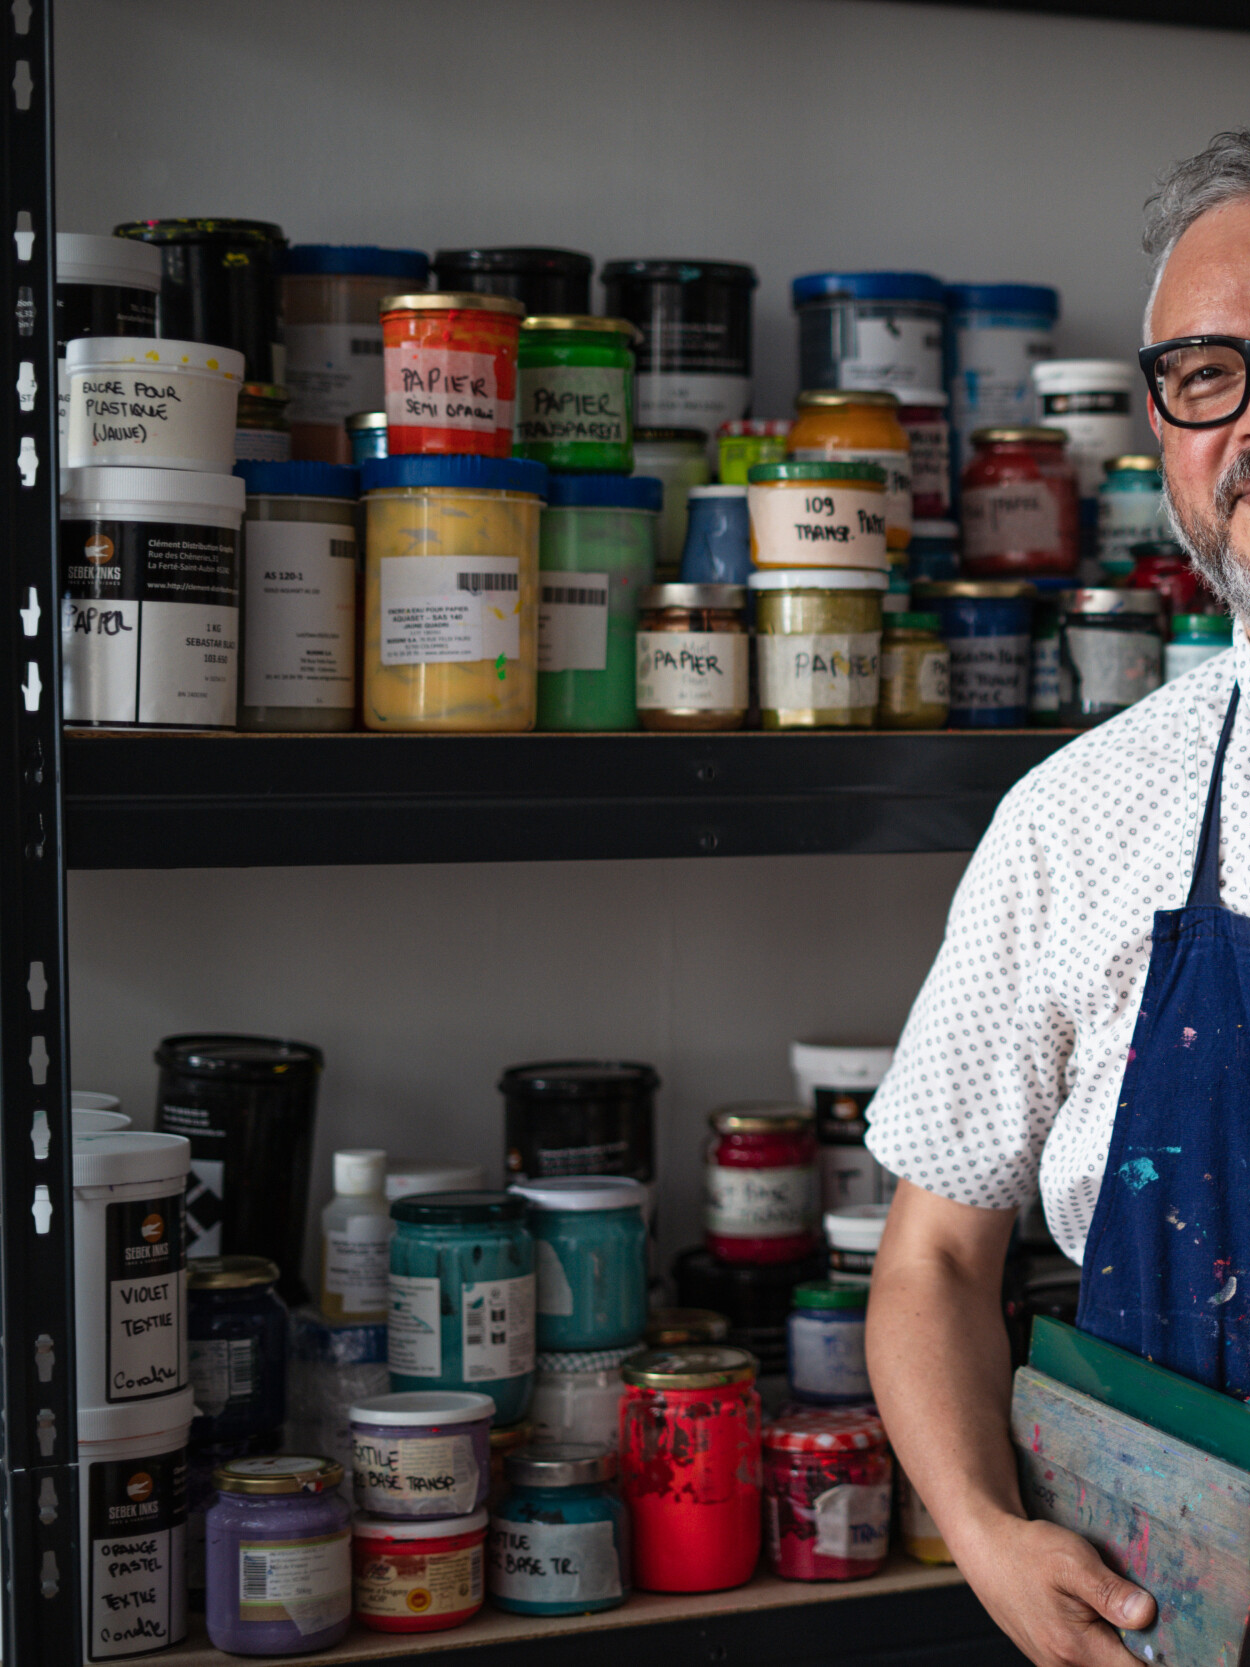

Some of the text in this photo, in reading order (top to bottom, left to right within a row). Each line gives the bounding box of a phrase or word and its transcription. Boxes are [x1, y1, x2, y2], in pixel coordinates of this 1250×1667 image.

[83, 382, 182, 402] ENCRE POUR
[401, 367, 489, 398] PAPIER
[86, 399, 169, 421] PLASTIQUE
[406, 398, 439, 418] SEMI
[534, 388, 621, 418] PAPIER
[93, 423, 148, 444] (JAUNE)
[806, 497, 835, 517] 109
[147, 539, 181, 549] Clément
[148, 551, 164, 559] Rue
[165, 552, 179, 560] des
[68, 566, 121, 581] SEBEK INKS
[264, 571, 304, 581] AS 120-1
[654, 650, 723, 676] PAPIER
[125, 1242, 169, 1261] SEBEK INKS
[120, 1283, 169, 1305] VIOLET
[121, 1313, 173, 1338] TEXTILE
[367, 1471, 403, 1491] BASE
[404, 1475, 457, 1493] TRANSP.
[109, 1504, 137, 1520] SEBEK
[138, 1501, 159, 1516] INKS
[101, 1540, 158, 1557] ORANGE
[108, 1558, 162, 1578] PASTEL
[504, 1554, 547, 1577] BASE
[101, 1588, 156, 1611] TEXTILE
